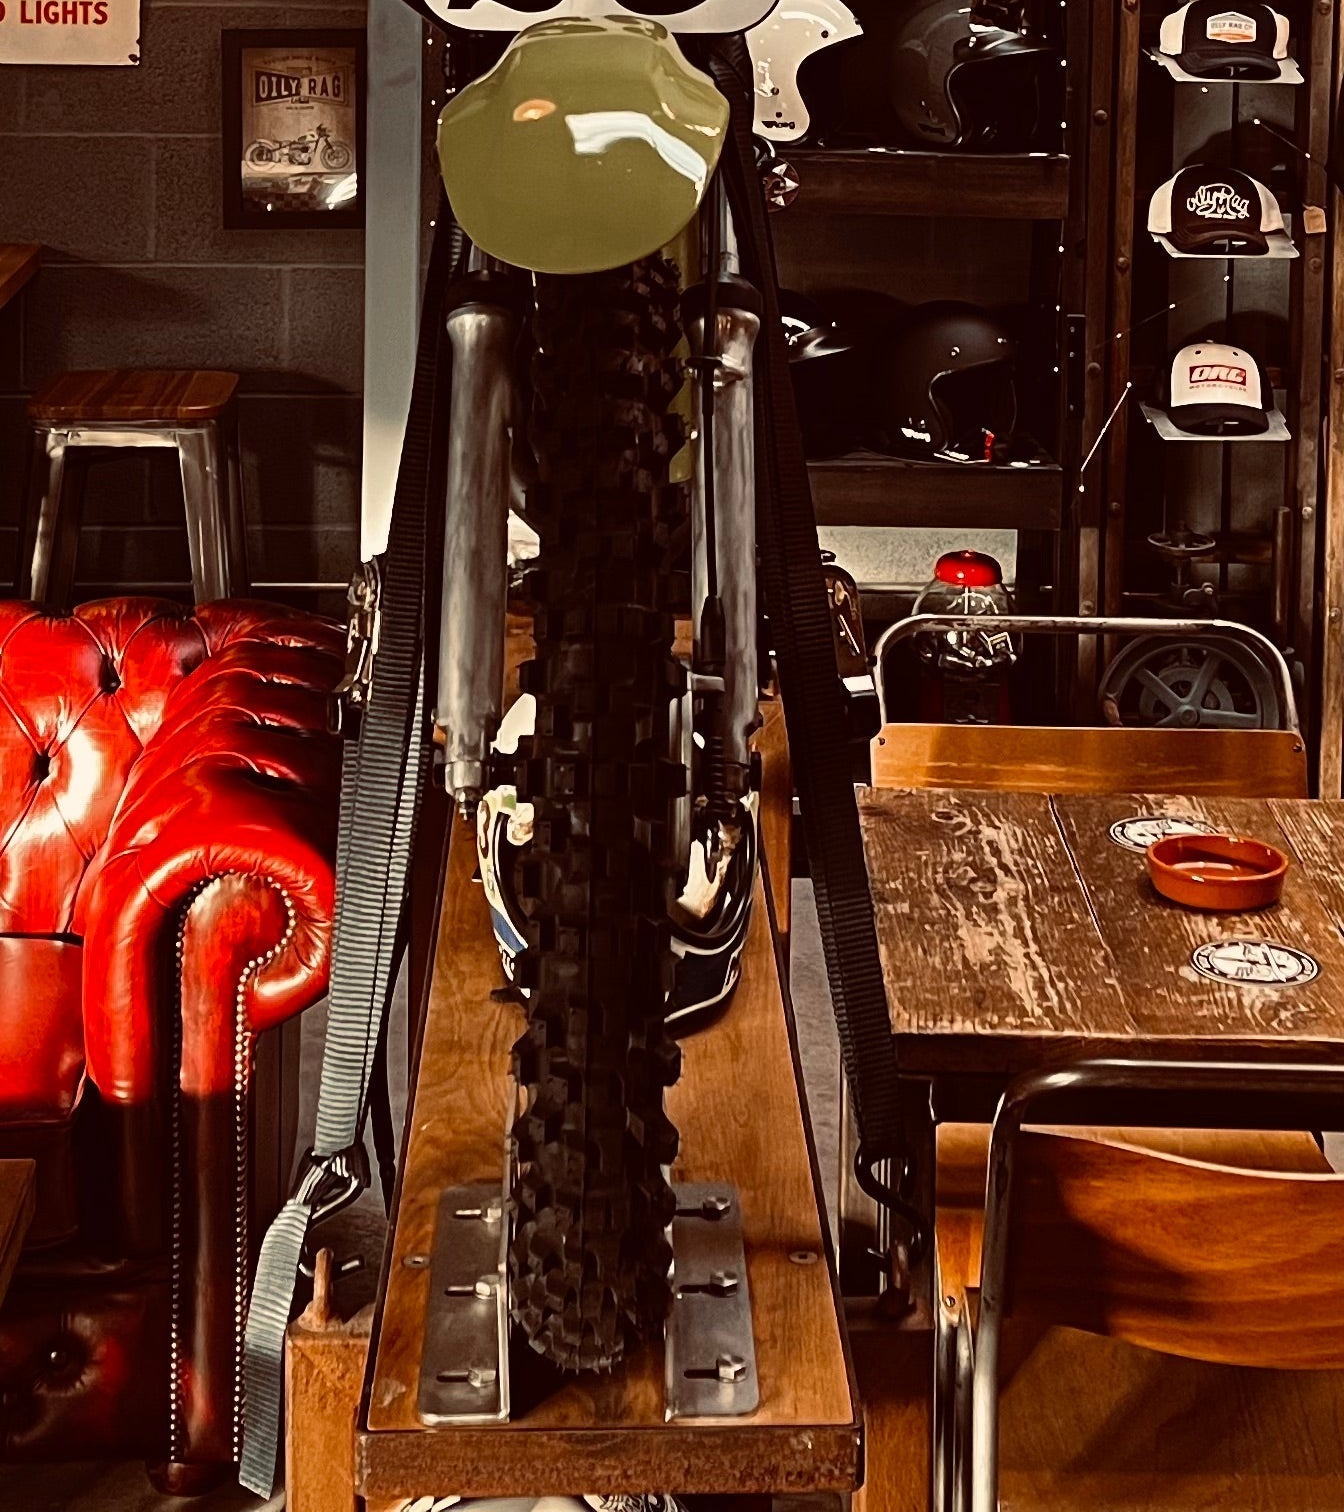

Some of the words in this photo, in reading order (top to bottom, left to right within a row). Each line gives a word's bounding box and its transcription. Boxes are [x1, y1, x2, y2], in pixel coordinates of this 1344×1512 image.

[20, 0, 109, 26] LIGHTS
[259, 75, 298, 98] OILY
[308, 74, 341, 98] RAG
[1190, 366, 1245, 383] ORC
